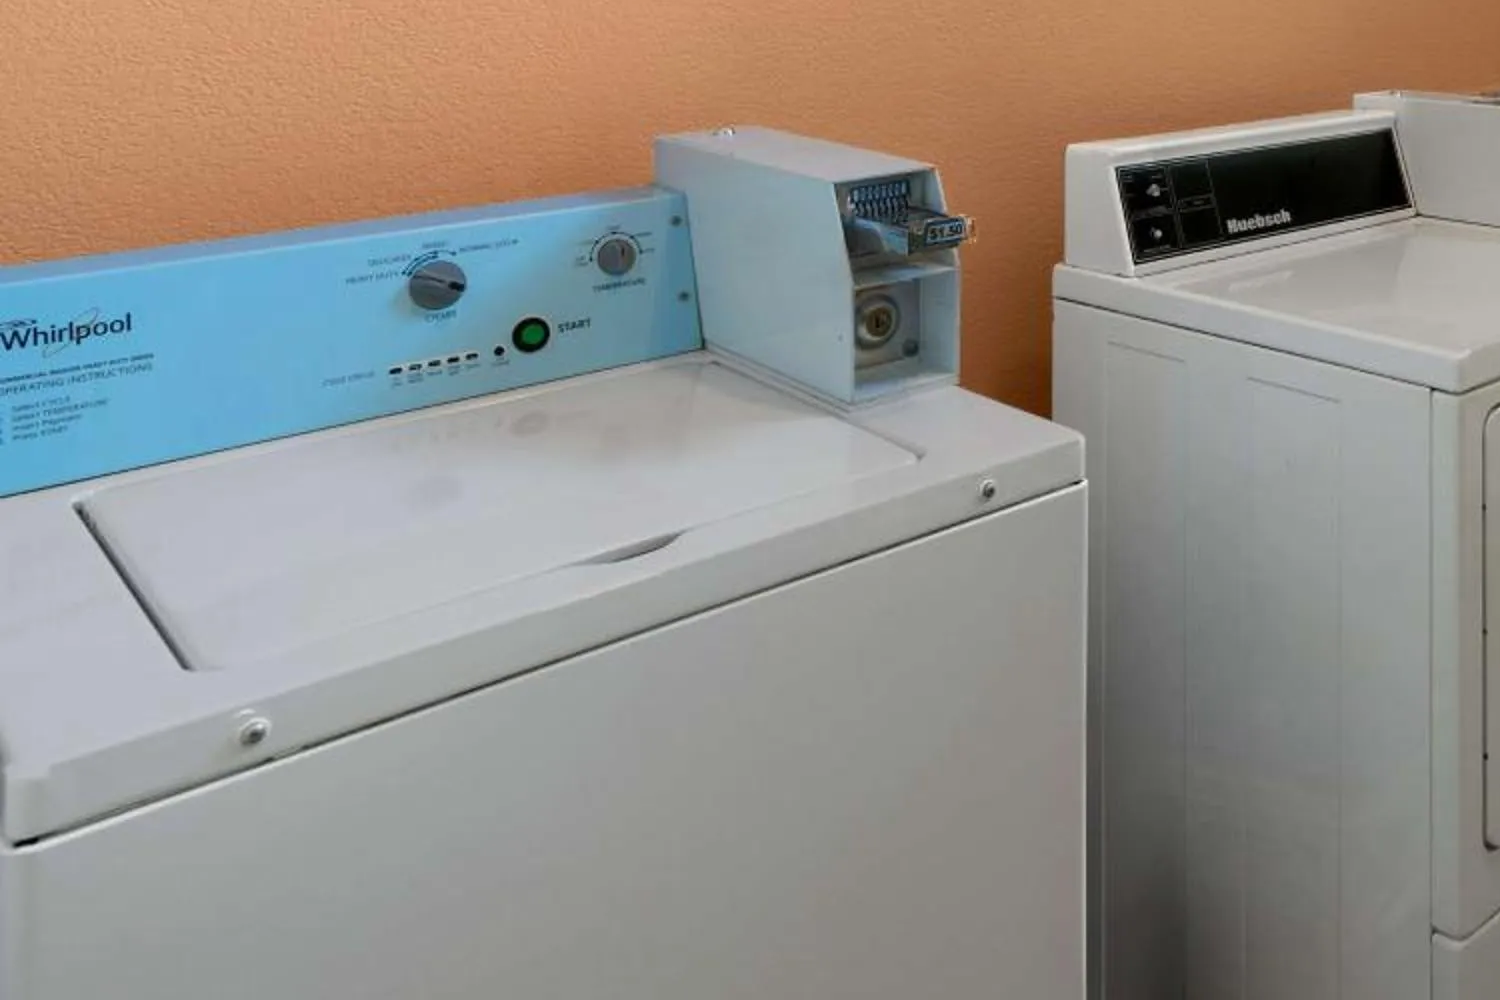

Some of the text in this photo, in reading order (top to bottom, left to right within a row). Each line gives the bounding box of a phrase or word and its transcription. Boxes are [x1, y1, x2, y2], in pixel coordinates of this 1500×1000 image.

[1225, 208, 1292, 234] Huebsch
[0, 311, 132, 352] Whirlpool
[558, 318, 591, 334] START
